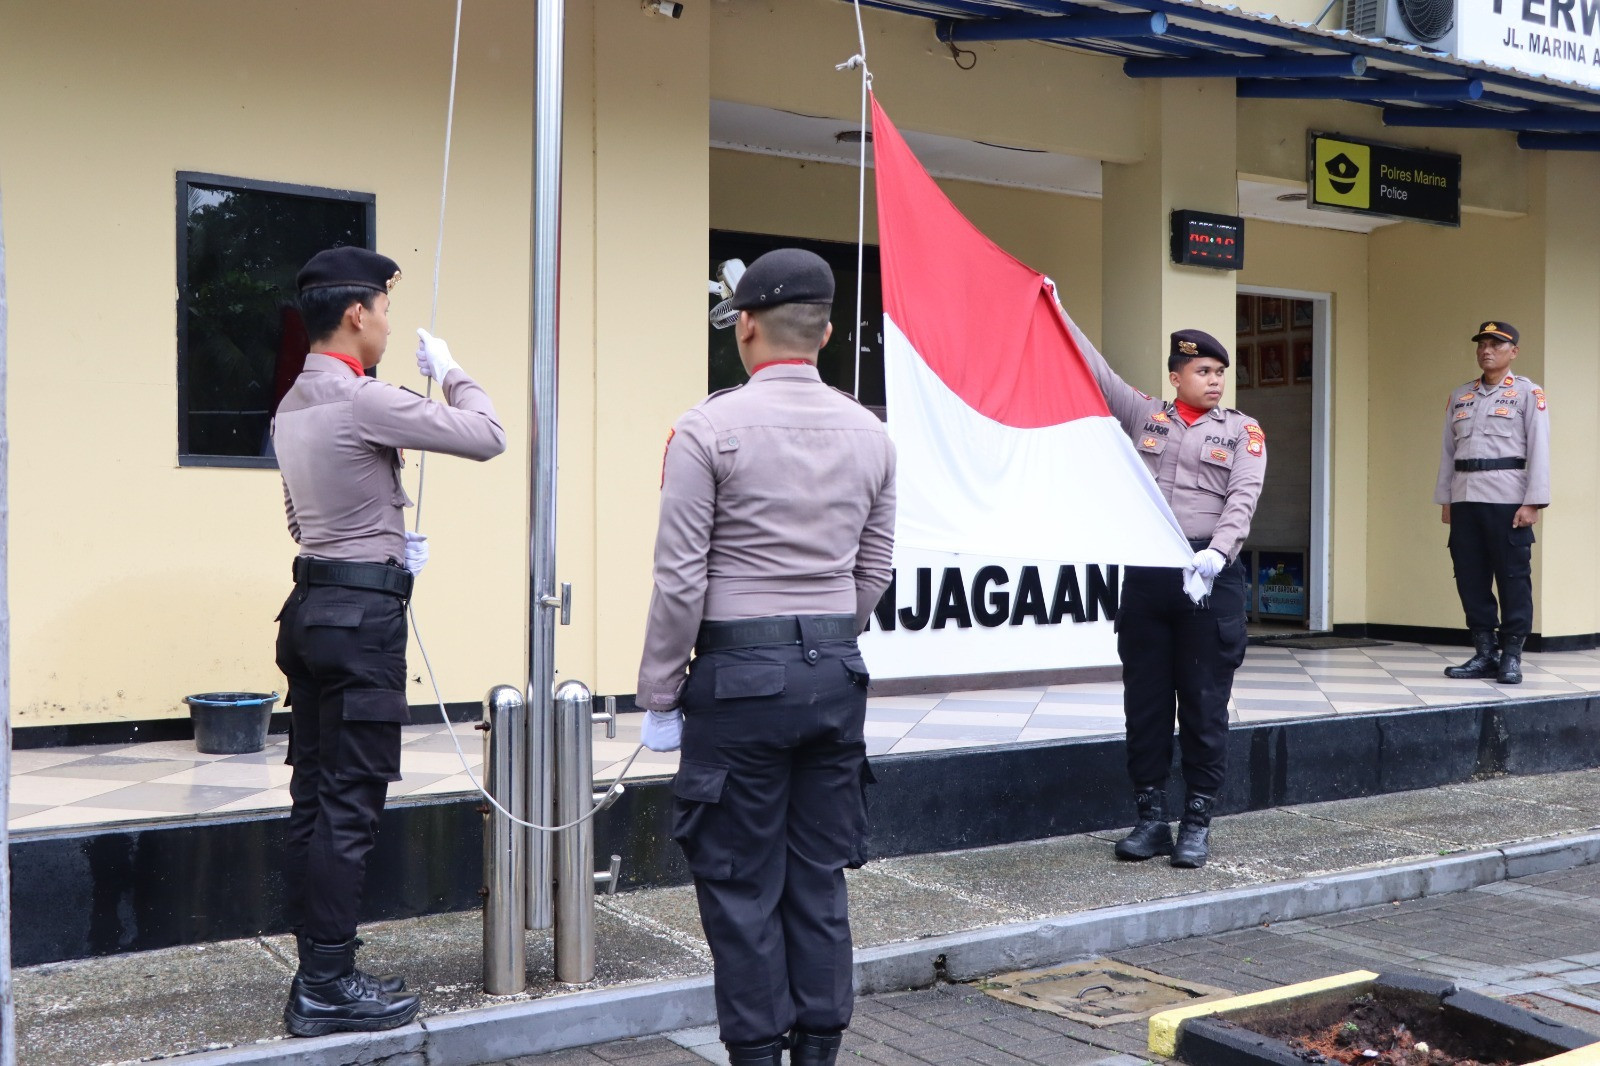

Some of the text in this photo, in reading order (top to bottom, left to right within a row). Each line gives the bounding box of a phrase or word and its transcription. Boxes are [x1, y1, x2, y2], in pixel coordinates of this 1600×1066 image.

[1503, 27, 1523, 50] JL.
[1529, 33, 1586, 64] MARINA
[1381, 164, 1447, 188] Polres Marina
[1380, 185, 1408, 200] Police
[1204, 435, 1238, 450] POLRI
